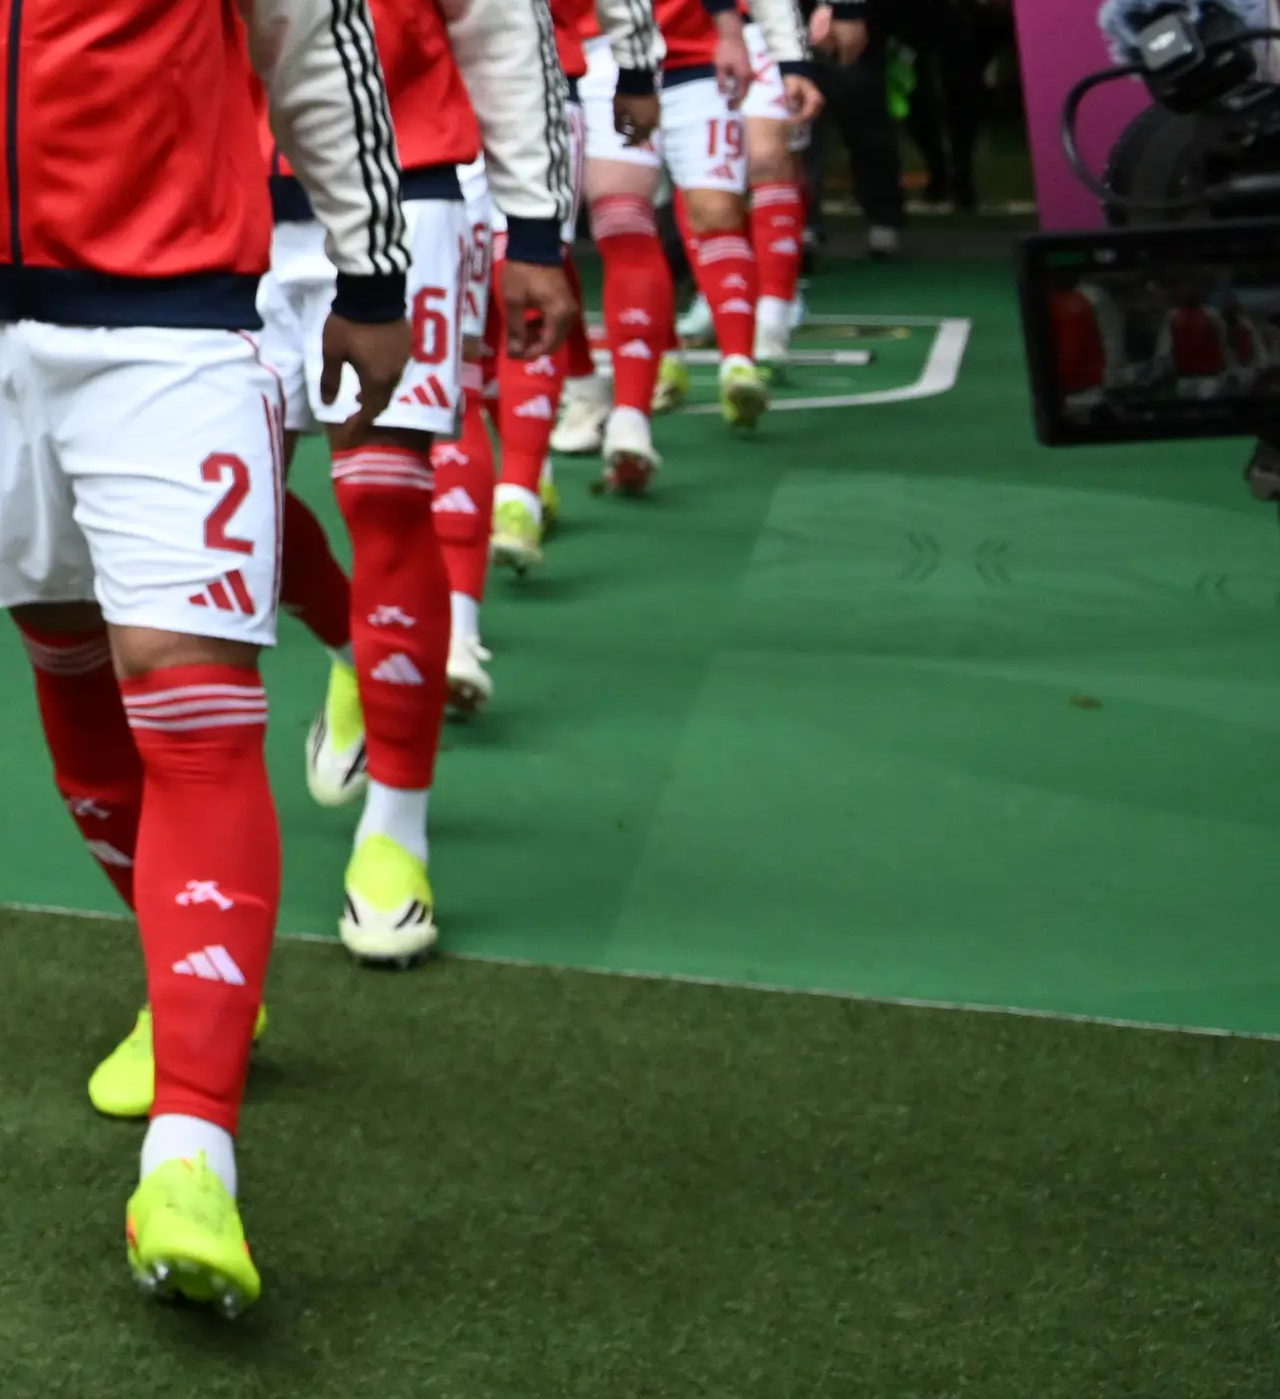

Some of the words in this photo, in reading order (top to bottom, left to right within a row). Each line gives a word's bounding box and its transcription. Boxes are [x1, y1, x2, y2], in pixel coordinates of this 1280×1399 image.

[707, 117, 745, 162] 19
[411, 287, 448, 365] 6
[202, 453, 253, 554] 2
